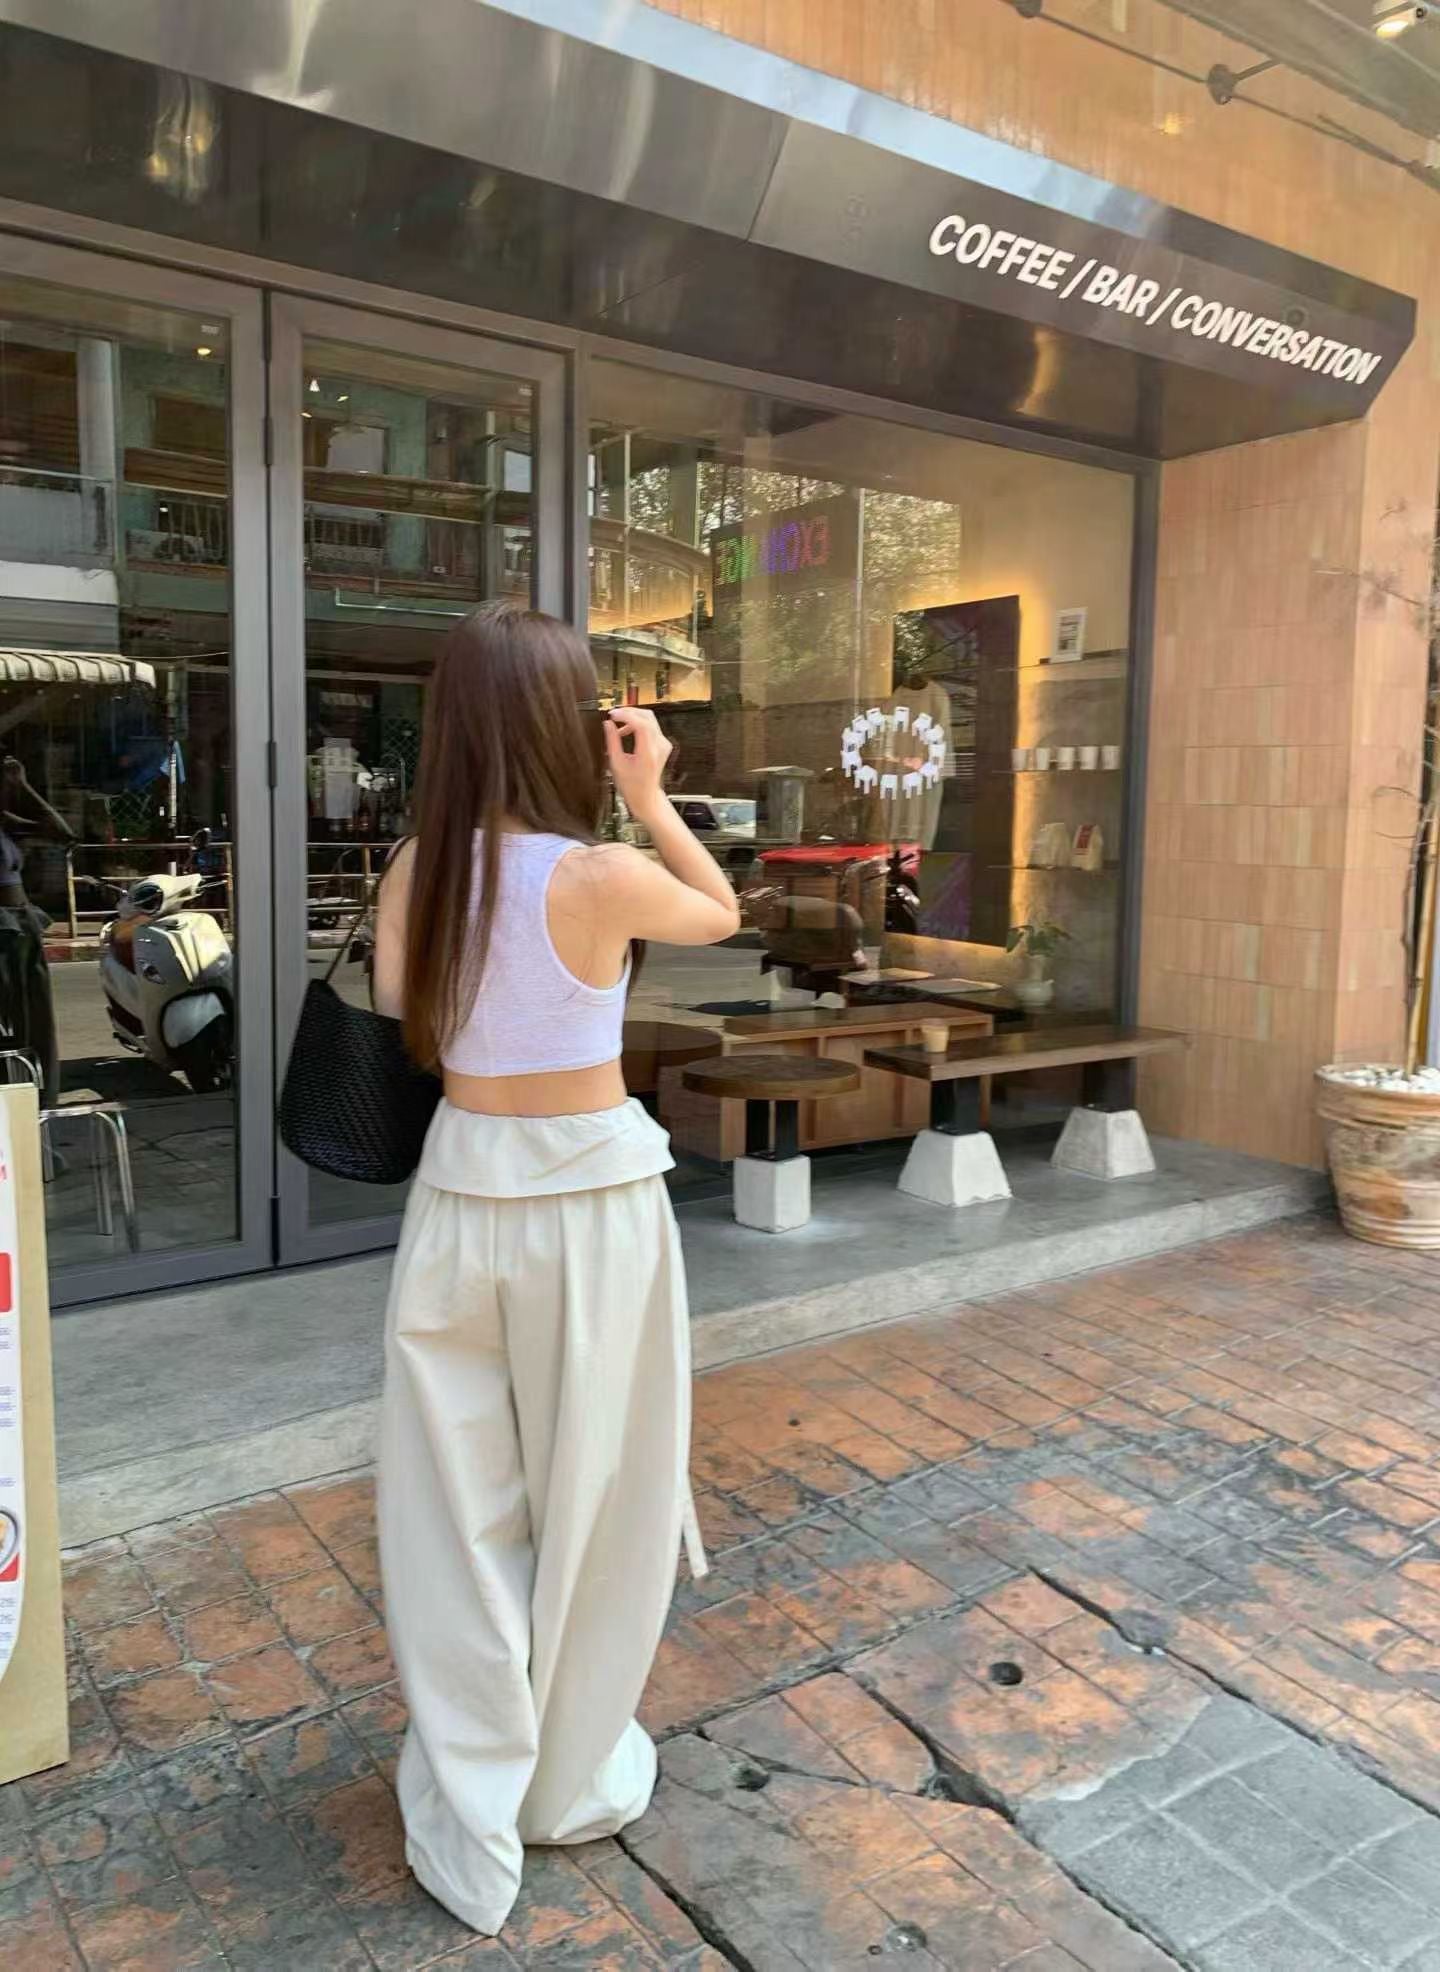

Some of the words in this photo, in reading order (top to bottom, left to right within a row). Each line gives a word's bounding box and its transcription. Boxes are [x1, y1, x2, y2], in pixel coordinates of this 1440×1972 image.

[929, 214, 1076, 290] COFFEE
[1081, 264, 1160, 317] BAR
[1170, 295, 1382, 385] CONVERSATION
